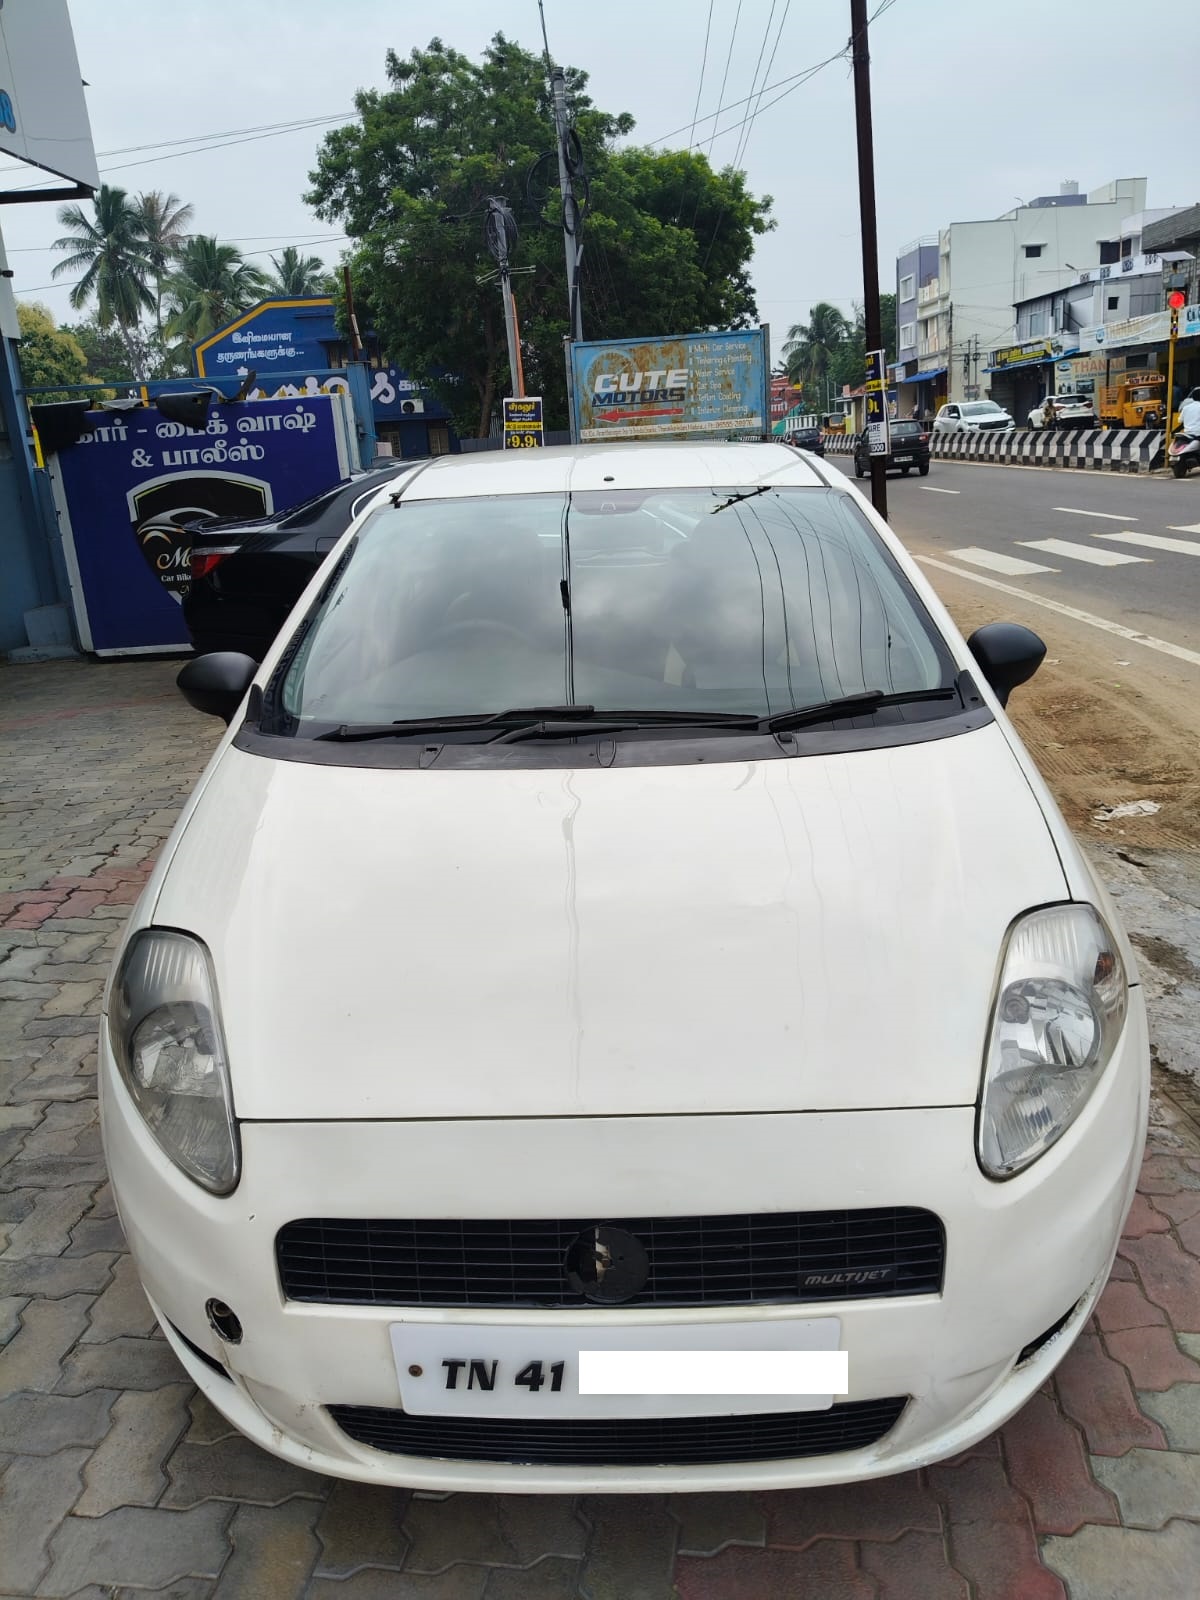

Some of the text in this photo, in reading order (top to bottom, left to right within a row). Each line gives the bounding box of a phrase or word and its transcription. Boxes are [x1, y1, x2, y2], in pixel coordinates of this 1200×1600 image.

[232, 331, 292, 344] இனிமையான
[595, 368, 688, 393] CUTE
[592, 387, 686, 405] MOTORS
[237, 405, 316, 433] வாஷ்
[131, 437, 265, 467] & பாலீஸ்
[161, 574, 175, 582] Car
[804, 1269, 891, 1286] MULTIJET
[441, 1359, 565, 1392] TN 41
